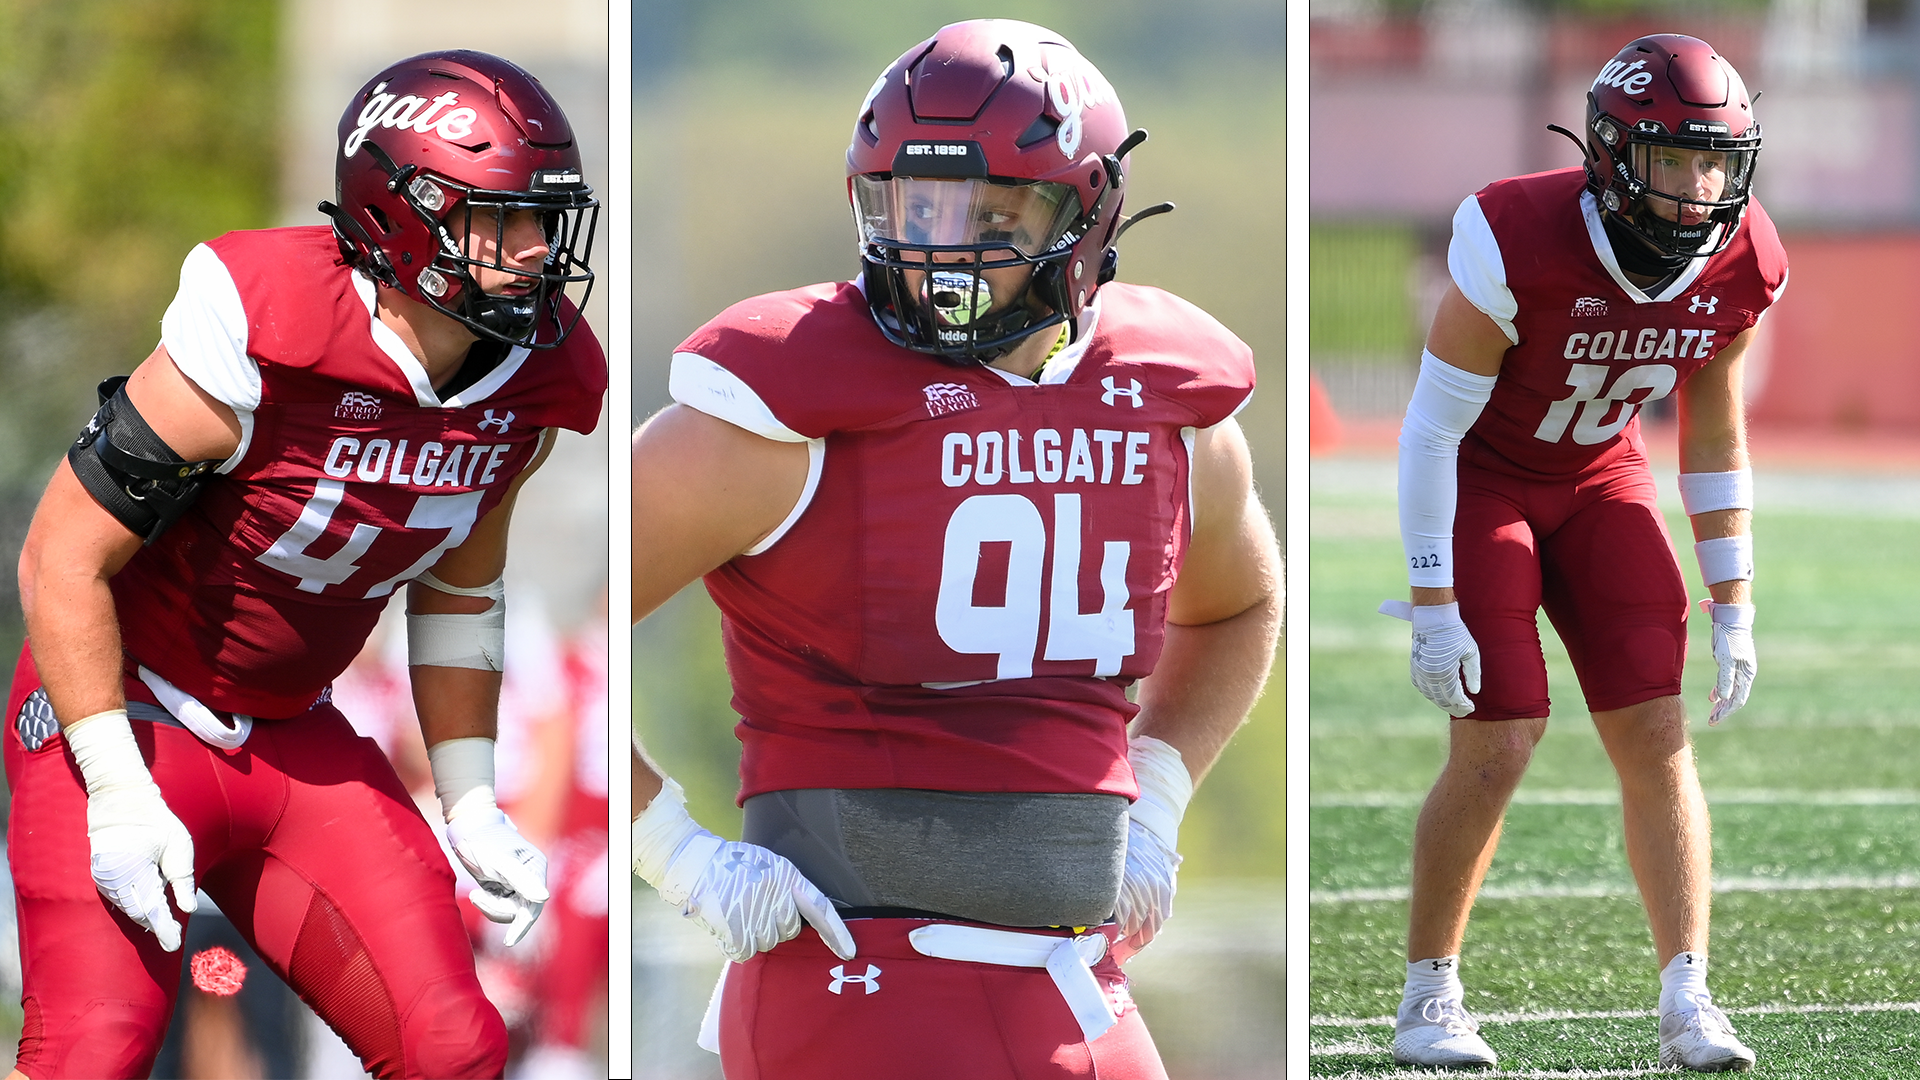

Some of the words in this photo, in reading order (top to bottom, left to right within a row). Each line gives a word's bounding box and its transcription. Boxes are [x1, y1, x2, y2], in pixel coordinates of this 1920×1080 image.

[906, 144, 933, 156] EST.
[934, 144, 967, 156] 1890
[1563, 328, 1717, 361] COLGATE
[335, 404, 385, 415] PATRIOT
[926, 391, 977, 410] PATRIOT
[928, 399, 981, 418] LEAGUE
[1533, 363, 1678, 446] 10
[334, 410, 382, 421] LEAGUE
[323, 436, 512, 488] COLGATE
[940, 428, 1150, 488] COLGATE
[254, 477, 487, 600] 47
[1410, 553, 1442, 569] 222
[934, 492, 1136, 680] 94
